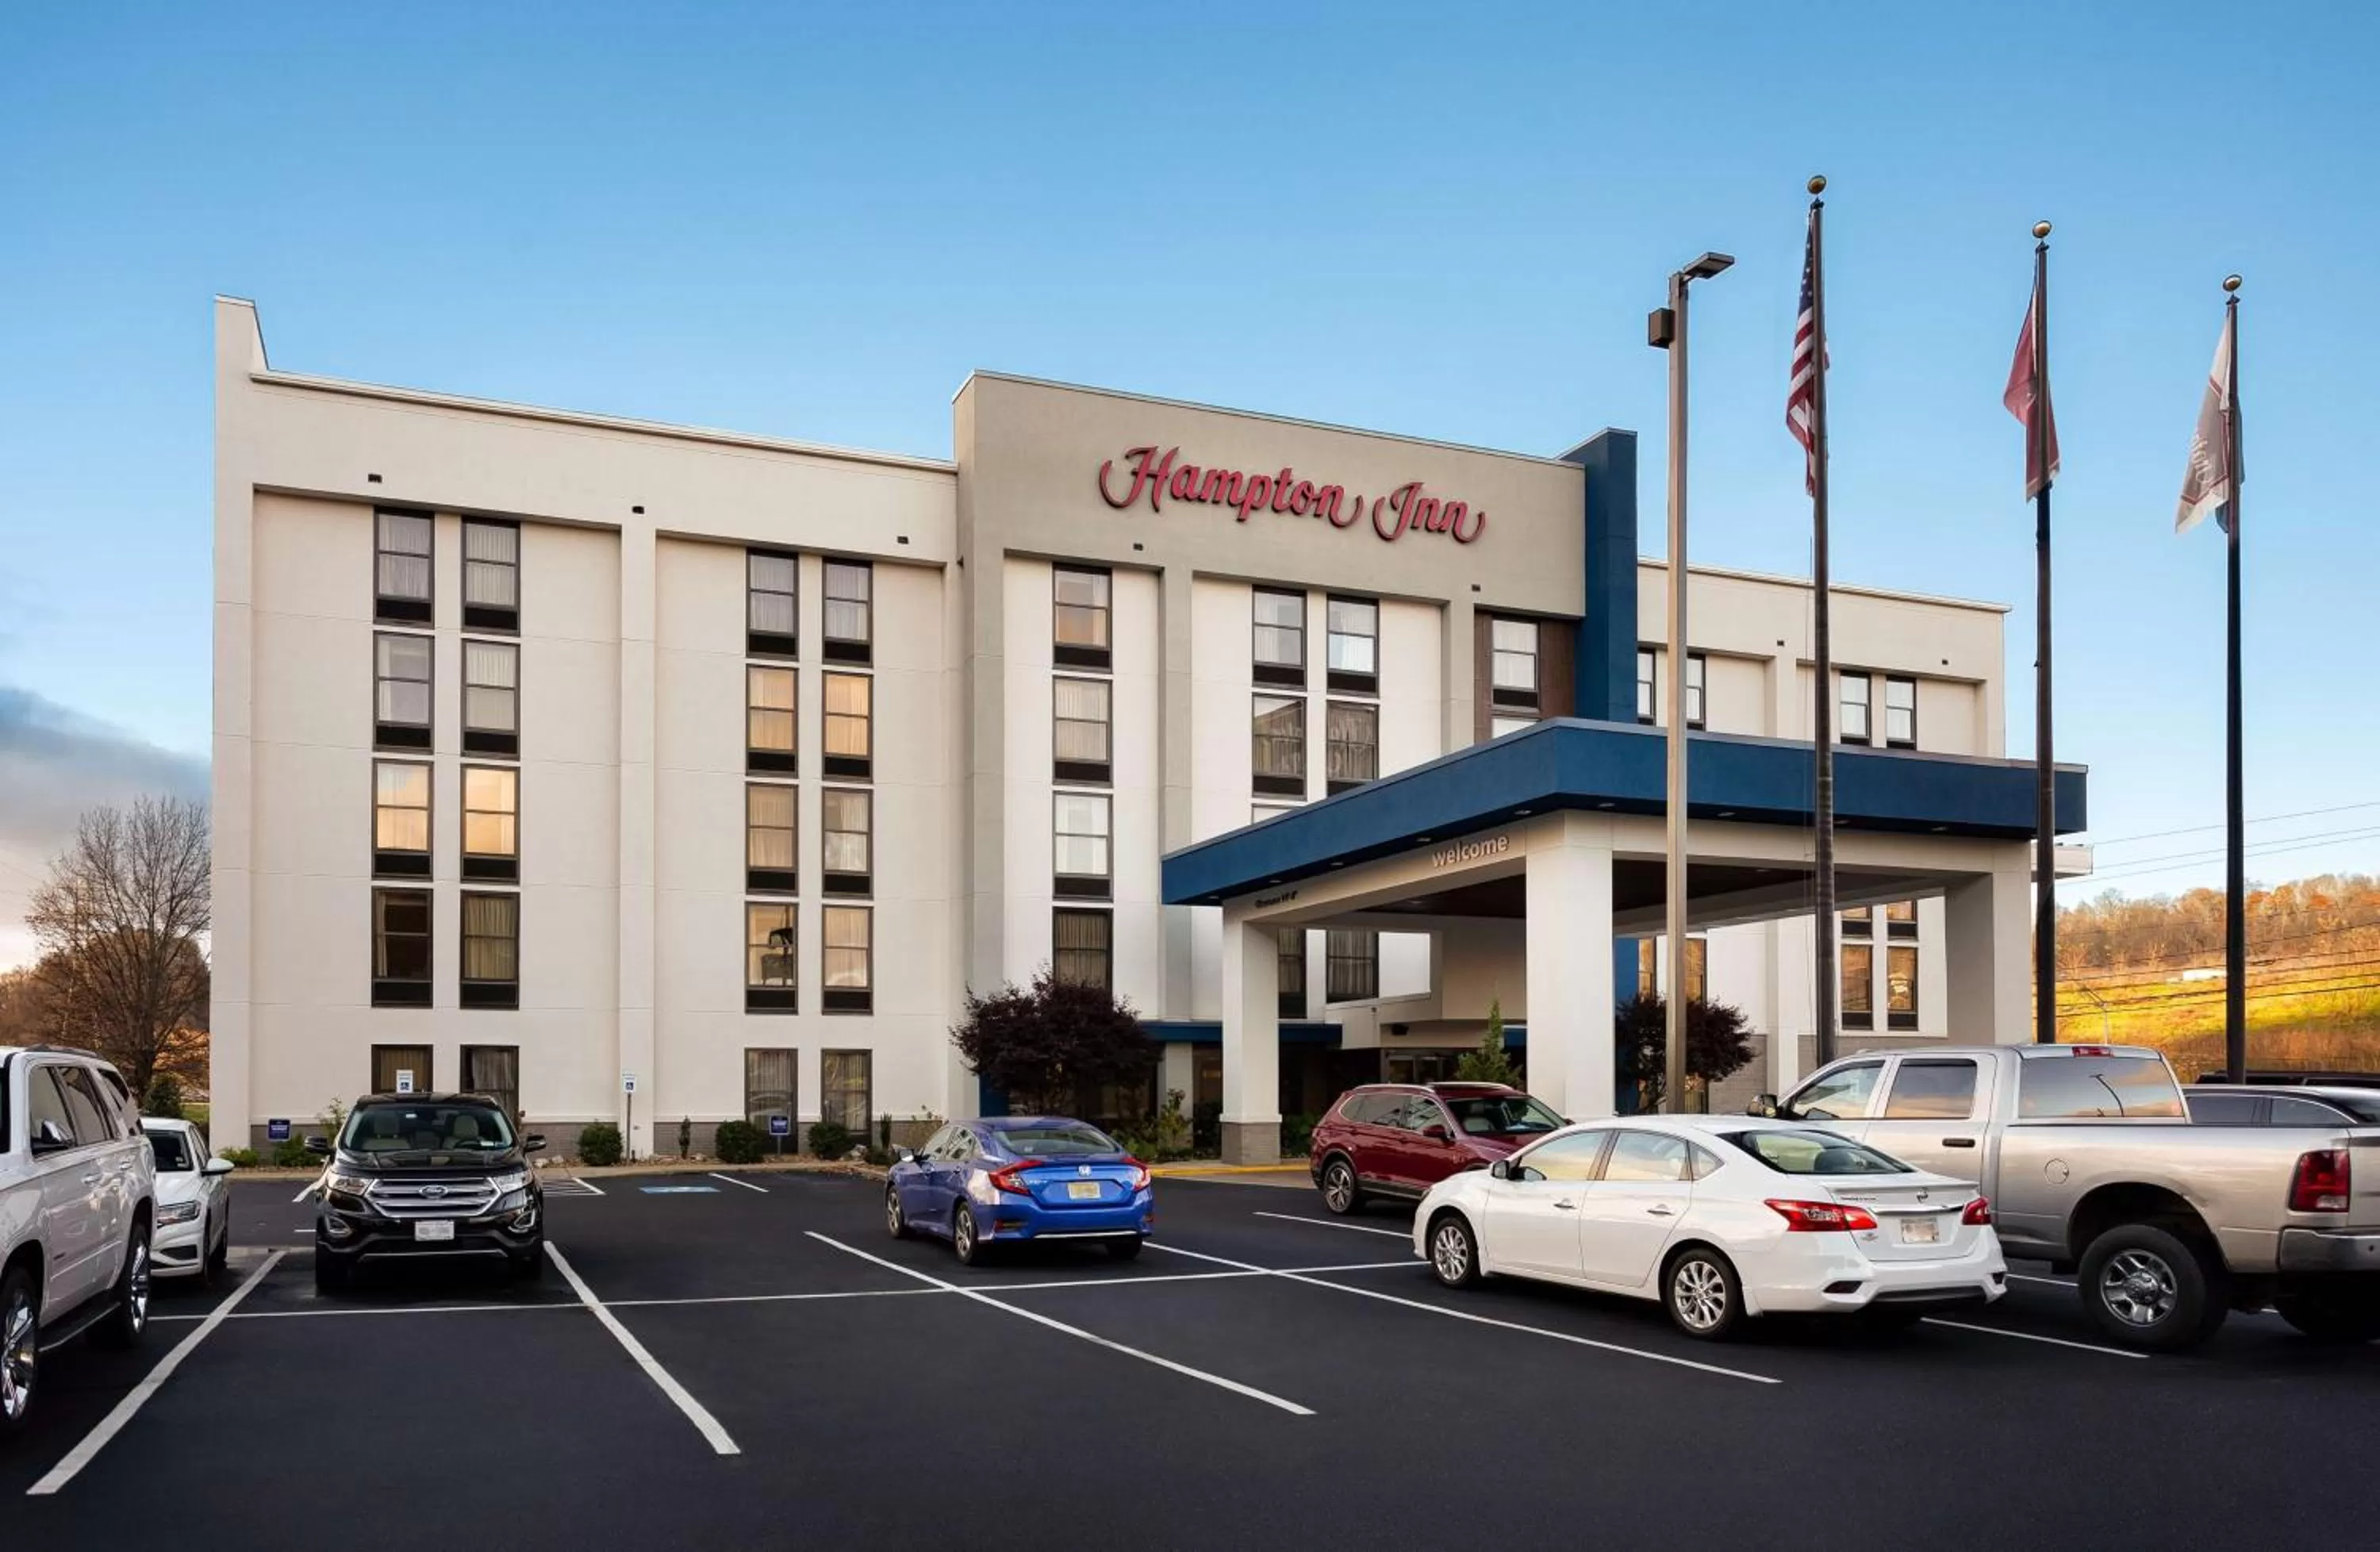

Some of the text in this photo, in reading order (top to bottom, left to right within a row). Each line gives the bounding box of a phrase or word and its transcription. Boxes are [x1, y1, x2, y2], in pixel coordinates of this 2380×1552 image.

[1099, 446, 1486, 544] Hampton Inn
[1432, 835, 1509, 867] welcome
